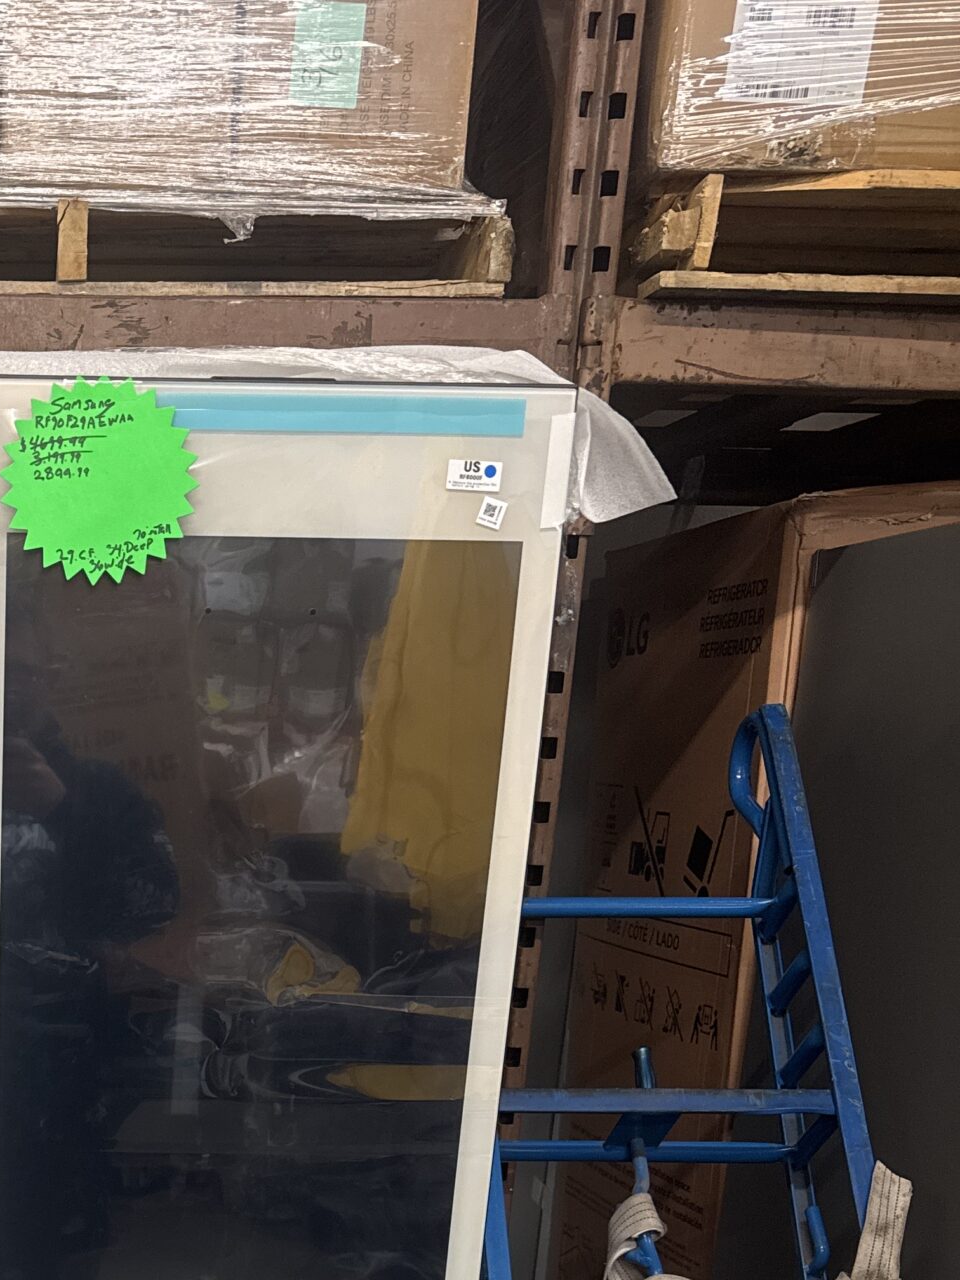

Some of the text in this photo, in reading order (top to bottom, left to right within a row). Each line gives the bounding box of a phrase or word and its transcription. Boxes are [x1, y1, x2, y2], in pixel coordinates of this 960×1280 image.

[401, 40, 415, 83] CHINA
[401, 86, 411, 99] IN
[464, 460, 481, 473] US
[707, 578, 768, 605] REFRIGERATOR
[699, 607, 765, 632] RÉFRIGÉRATEUR
[625, 611, 650, 656] LG
[699, 635, 762, 659] REFRIGERADOR
[656, 931, 679, 951] LADO
